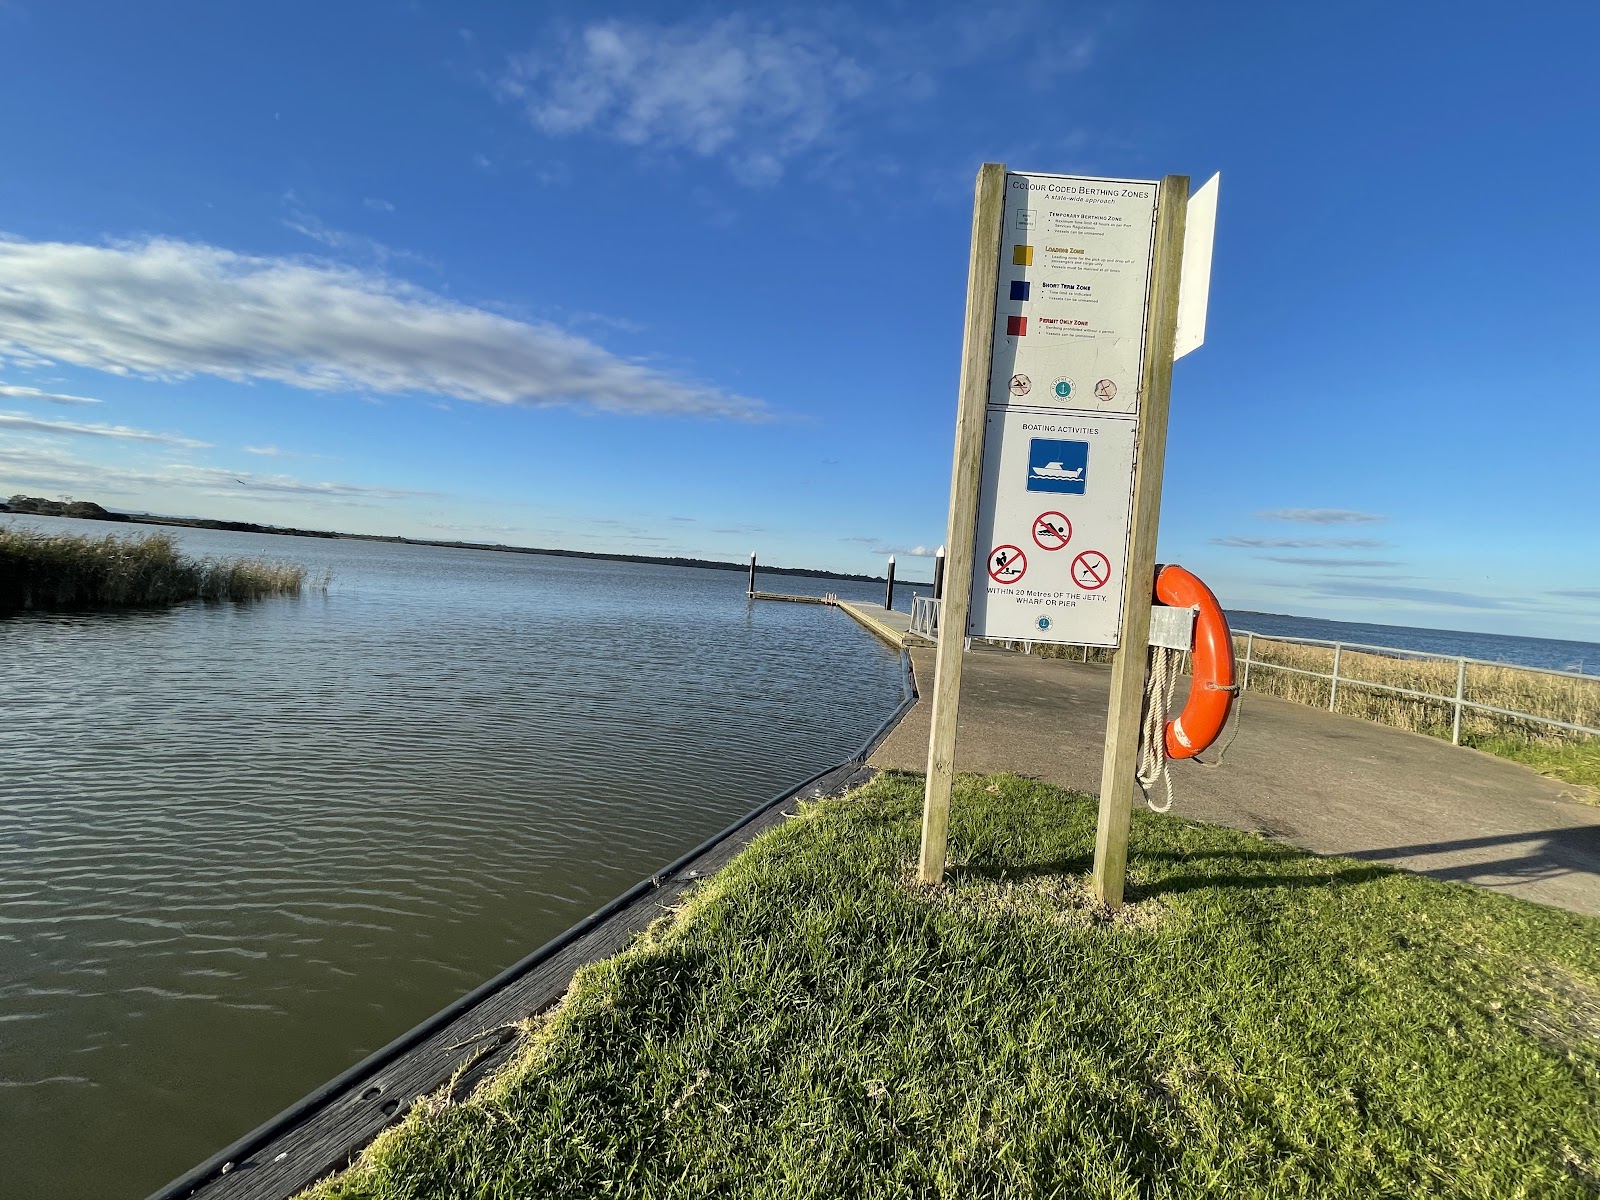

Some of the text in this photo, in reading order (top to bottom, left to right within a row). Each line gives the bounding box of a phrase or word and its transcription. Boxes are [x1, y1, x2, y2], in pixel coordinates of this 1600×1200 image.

[1013, 181, 1149, 198] COLOUR CODED BERTHING ZONES
[1023, 424, 1055, 432] BOATING
[987, 587, 1014, 596] WITHIN
[1082, 594, 1107, 602] JETTY,
